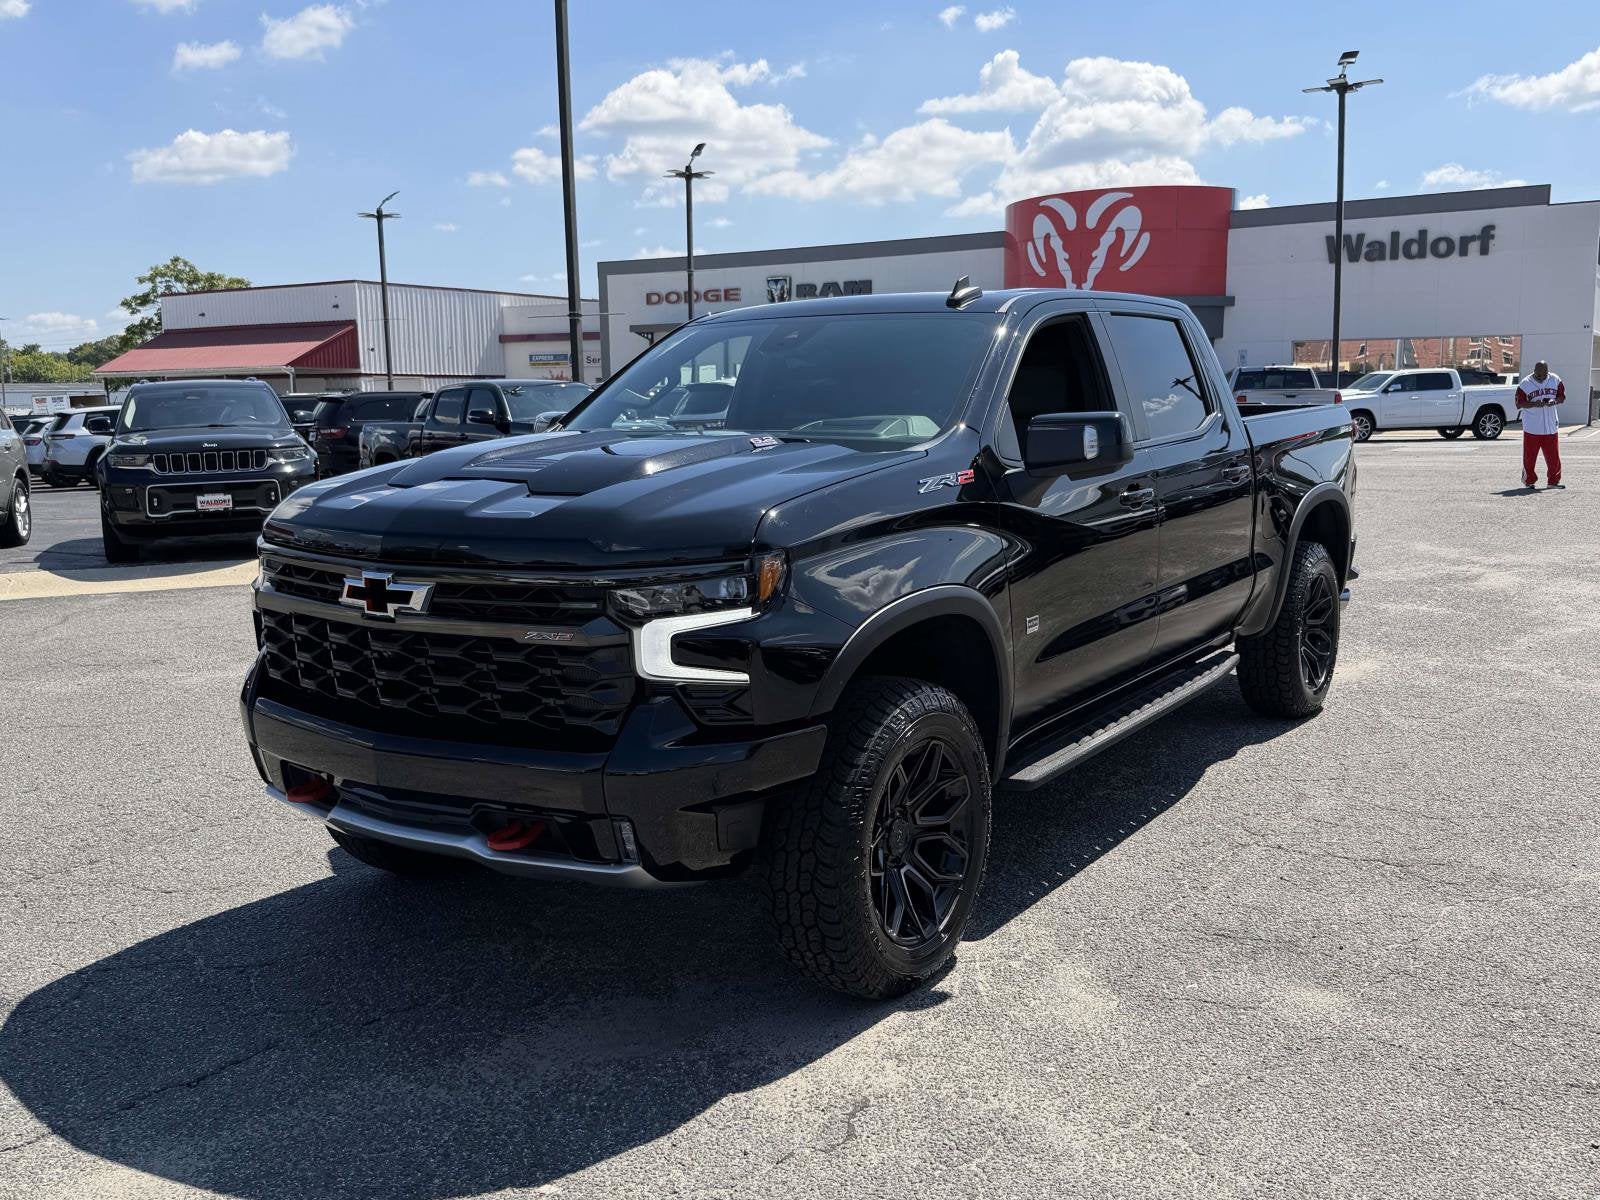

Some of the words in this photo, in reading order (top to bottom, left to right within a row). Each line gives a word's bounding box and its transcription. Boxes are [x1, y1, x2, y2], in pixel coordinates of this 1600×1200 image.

[1325, 224, 1496, 264] Waldorf
[645, 287, 742, 305] DODGE
[796, 279, 872, 298] RAM
[918, 469, 975, 494] ZR2
